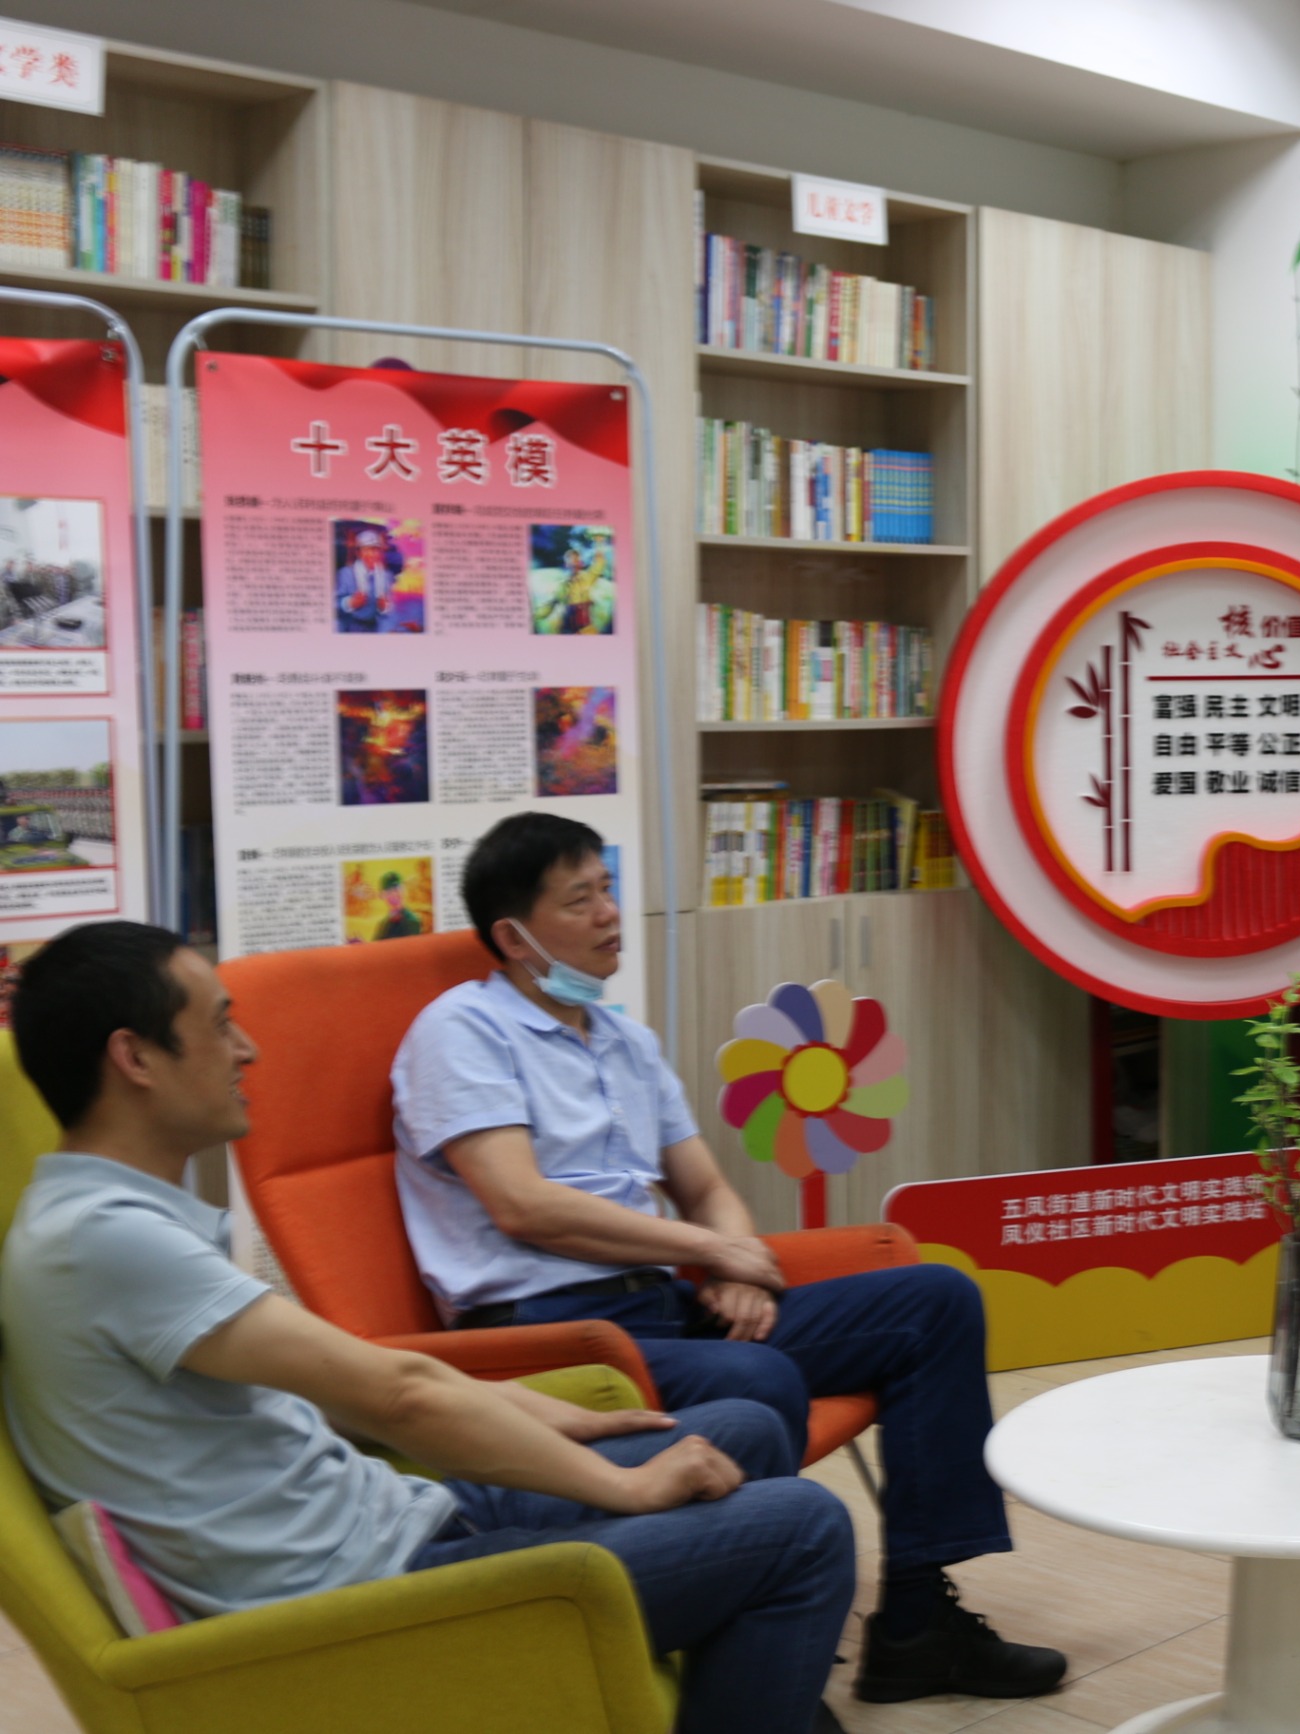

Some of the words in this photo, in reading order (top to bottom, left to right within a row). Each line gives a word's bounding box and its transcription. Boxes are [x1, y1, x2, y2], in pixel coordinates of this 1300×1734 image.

[0, 43, 78, 90] 学类
[291, 420, 559, 487] 十大英模
[1153, 694, 1197, 719] 富强
[1204, 694, 1249, 719] 民主
[1153, 732, 1197, 757] 自由
[1204, 732, 1249, 757] 平等
[1153, 770, 1197, 795] 爱国
[1204, 770, 1249, 795] 敬业
